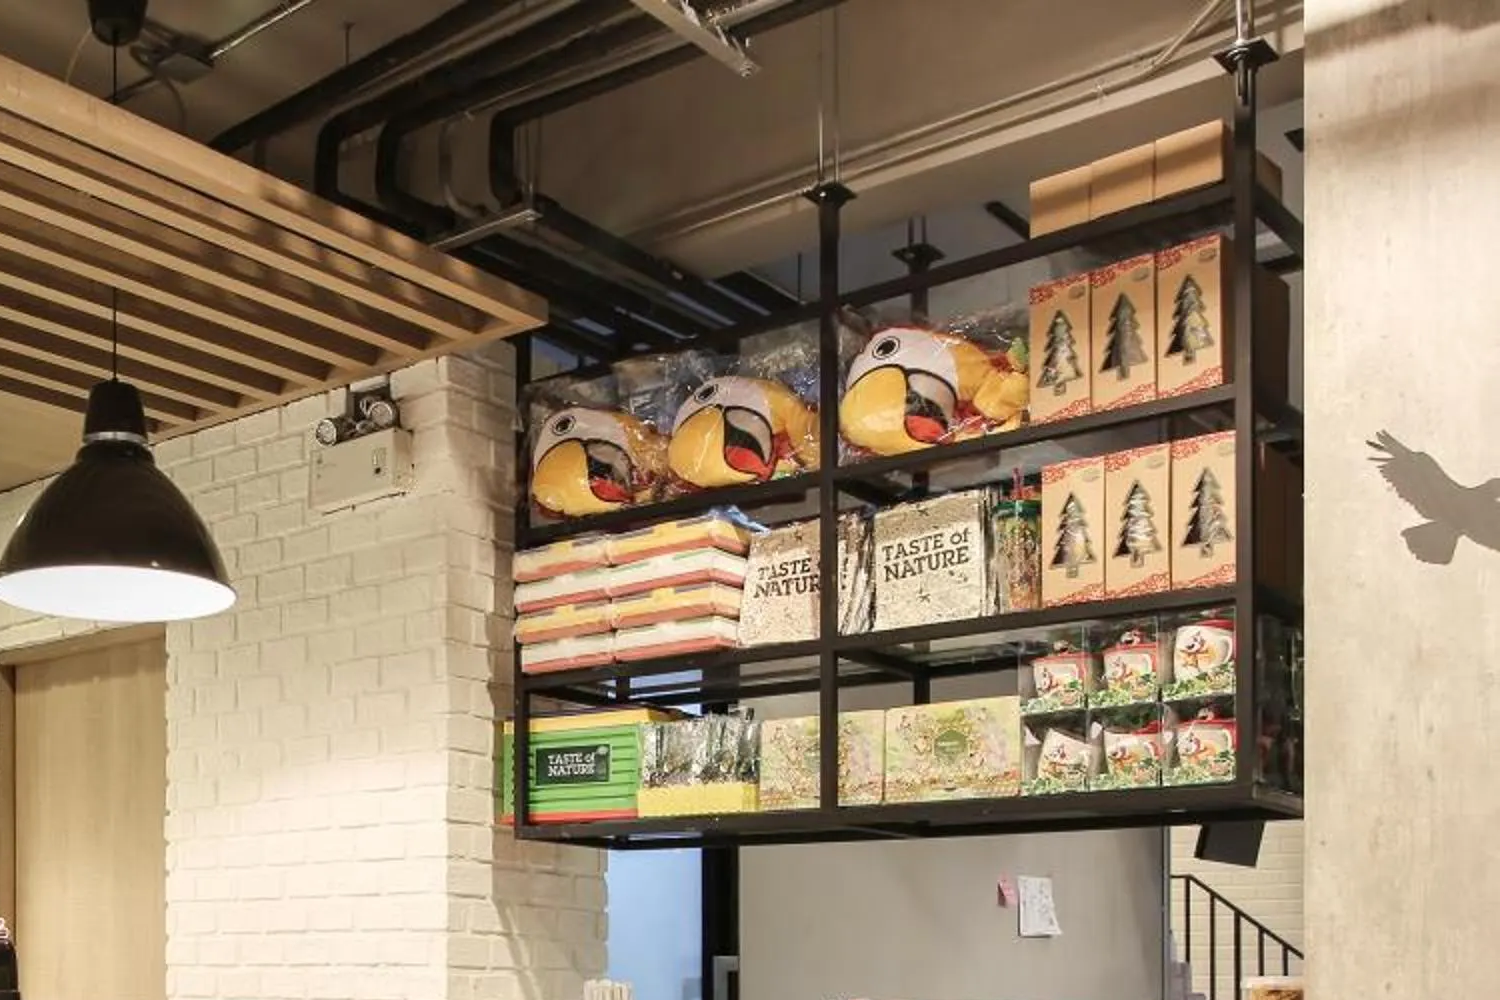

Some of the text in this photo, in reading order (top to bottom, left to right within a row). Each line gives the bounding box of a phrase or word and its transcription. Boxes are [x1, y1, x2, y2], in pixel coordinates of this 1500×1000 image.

[881, 527, 971, 562] TASTE of
[757, 557, 811, 580] TASTE
[884, 546, 971, 582] NATURE
[753, 573, 820, 598] NATUR
[547, 752, 583, 767] TASTE
[548, 762, 595, 777] NATURE
